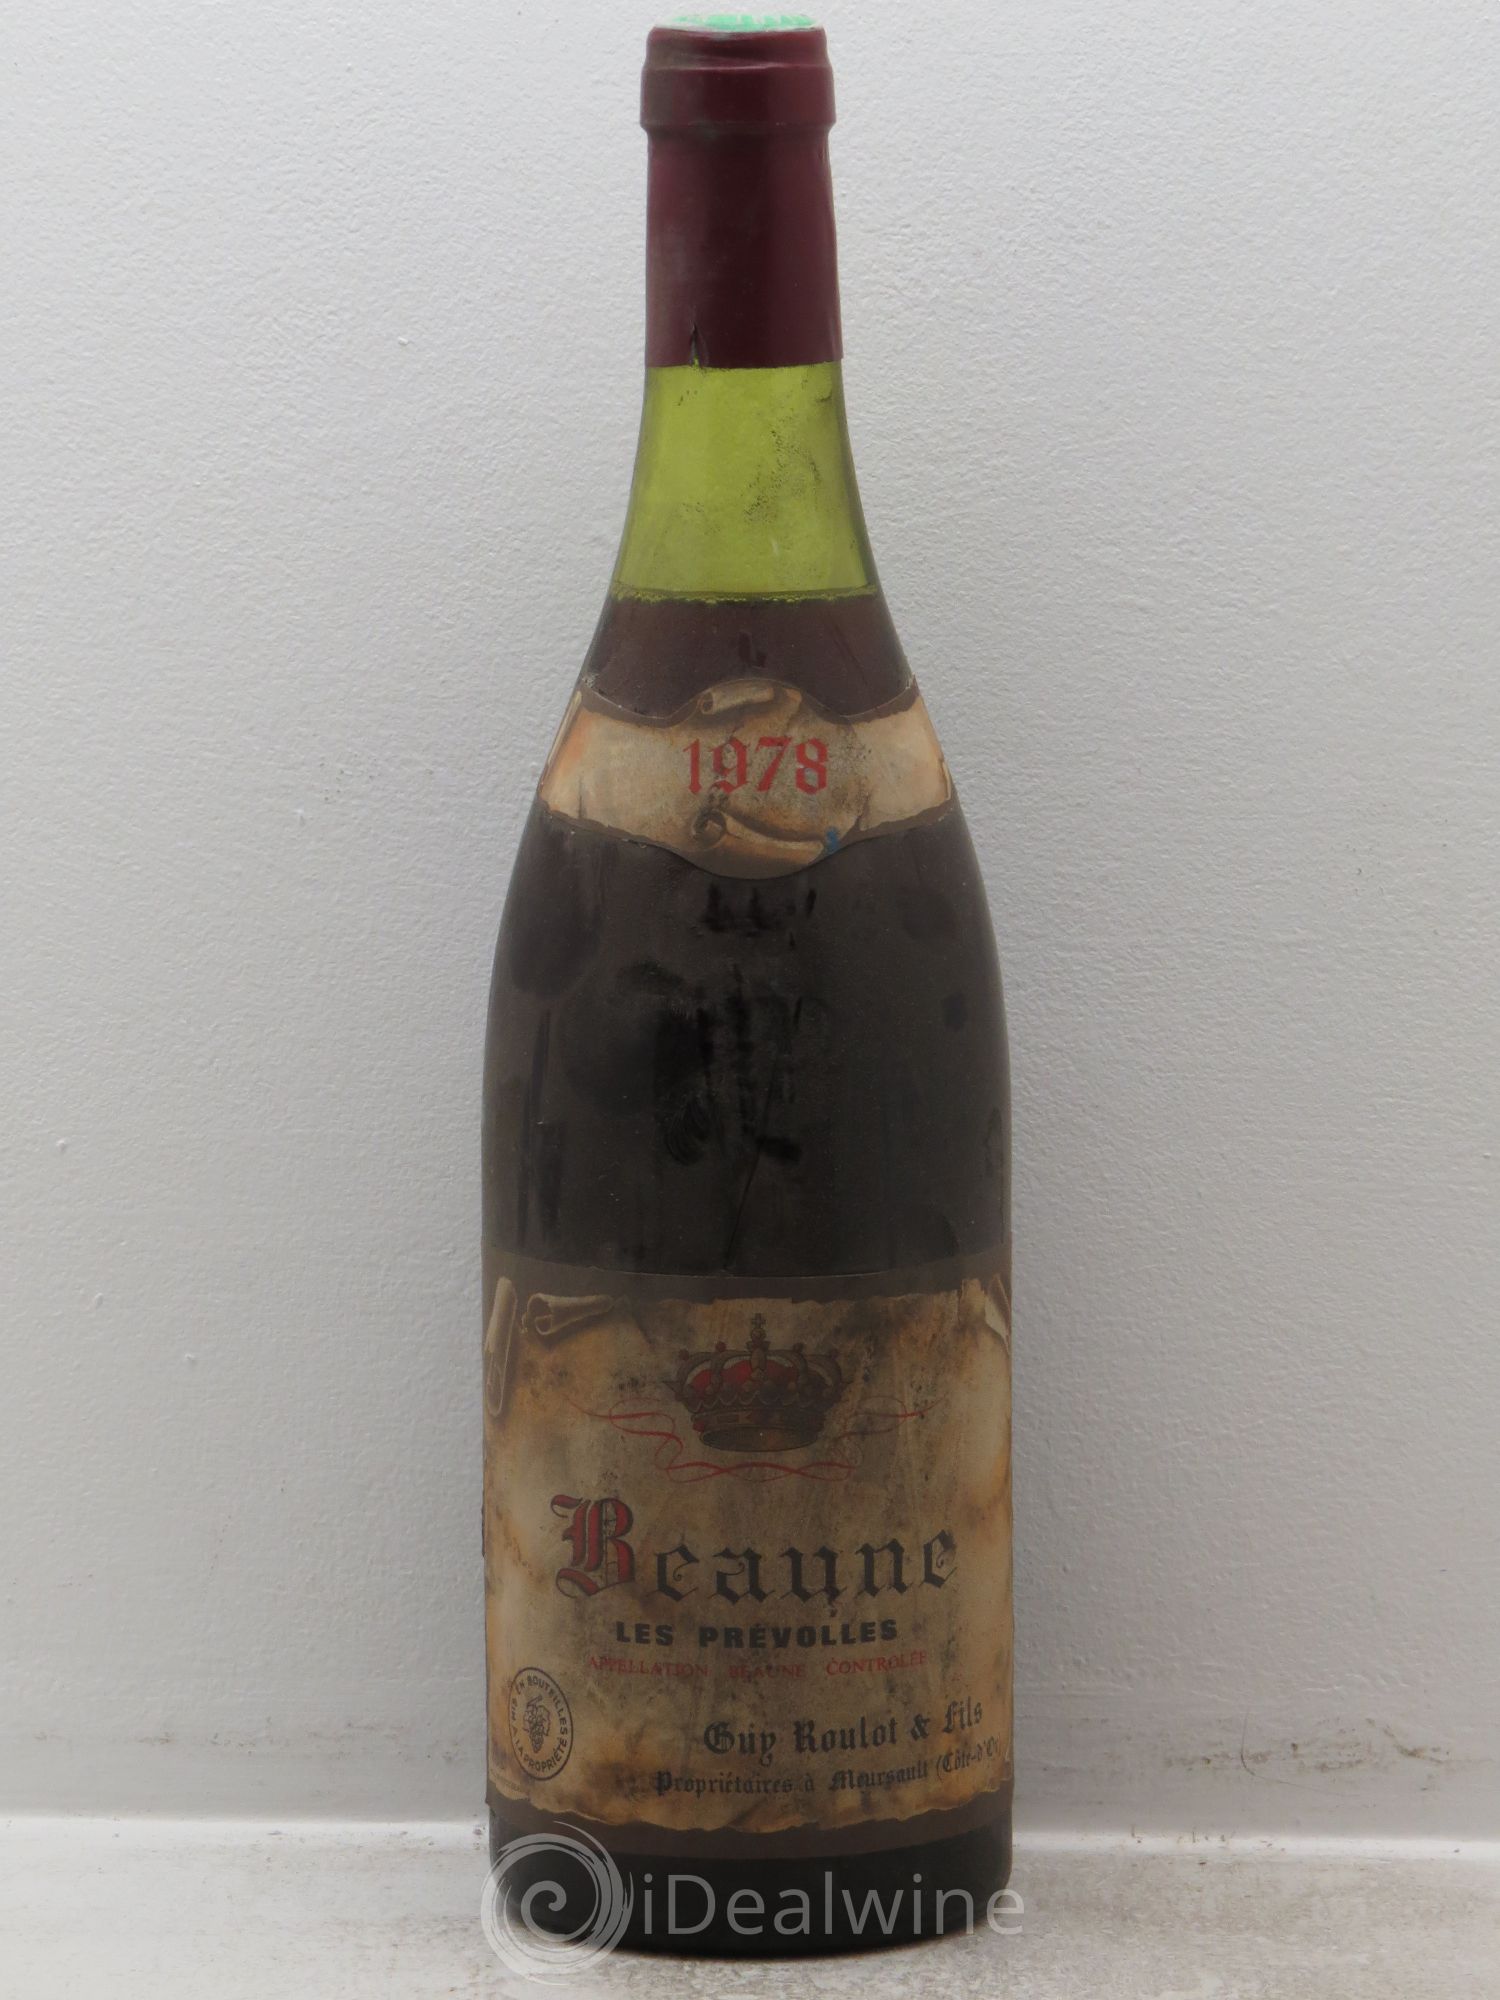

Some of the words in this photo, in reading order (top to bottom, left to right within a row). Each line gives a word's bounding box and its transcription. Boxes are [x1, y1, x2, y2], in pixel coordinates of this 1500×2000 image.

[683, 735, 828, 796] 1978
[550, 1494, 958, 1606] Beaune
[615, 1621, 674, 1647] LES
[699, 1619, 898, 1649] PRÉVOLLES
[588, 1655, 709, 1680] APPELLATION
[728, 1663, 807, 1680] BEAUNE
[703, 1720, 776, 1767] Guy
[792, 1715, 899, 1753] Roulot
[910, 1713, 931, 1742] &
[942, 1696, 983, 1734] Fils
[655, 1770, 793, 1800] Propriétaires
[828, 1760, 928, 1791] Meursault
